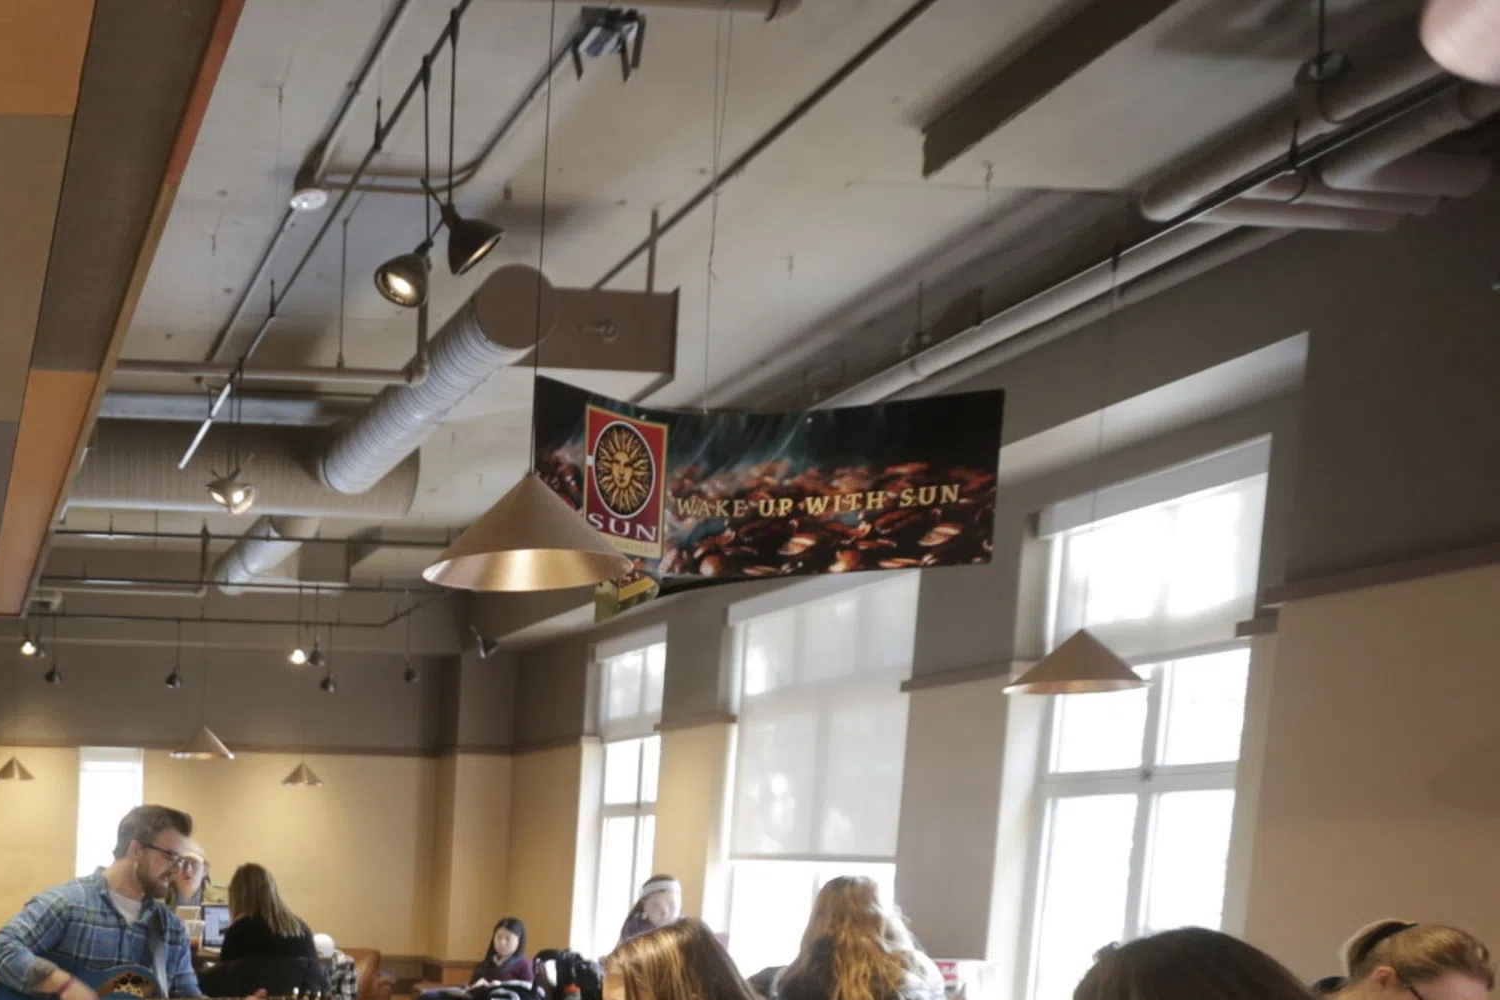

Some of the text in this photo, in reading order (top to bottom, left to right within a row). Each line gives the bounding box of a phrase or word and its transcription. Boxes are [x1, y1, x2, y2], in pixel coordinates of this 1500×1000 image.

[676, 484, 961, 517] WAKE UP WITH SUN
[588, 513, 657, 542] SUN
